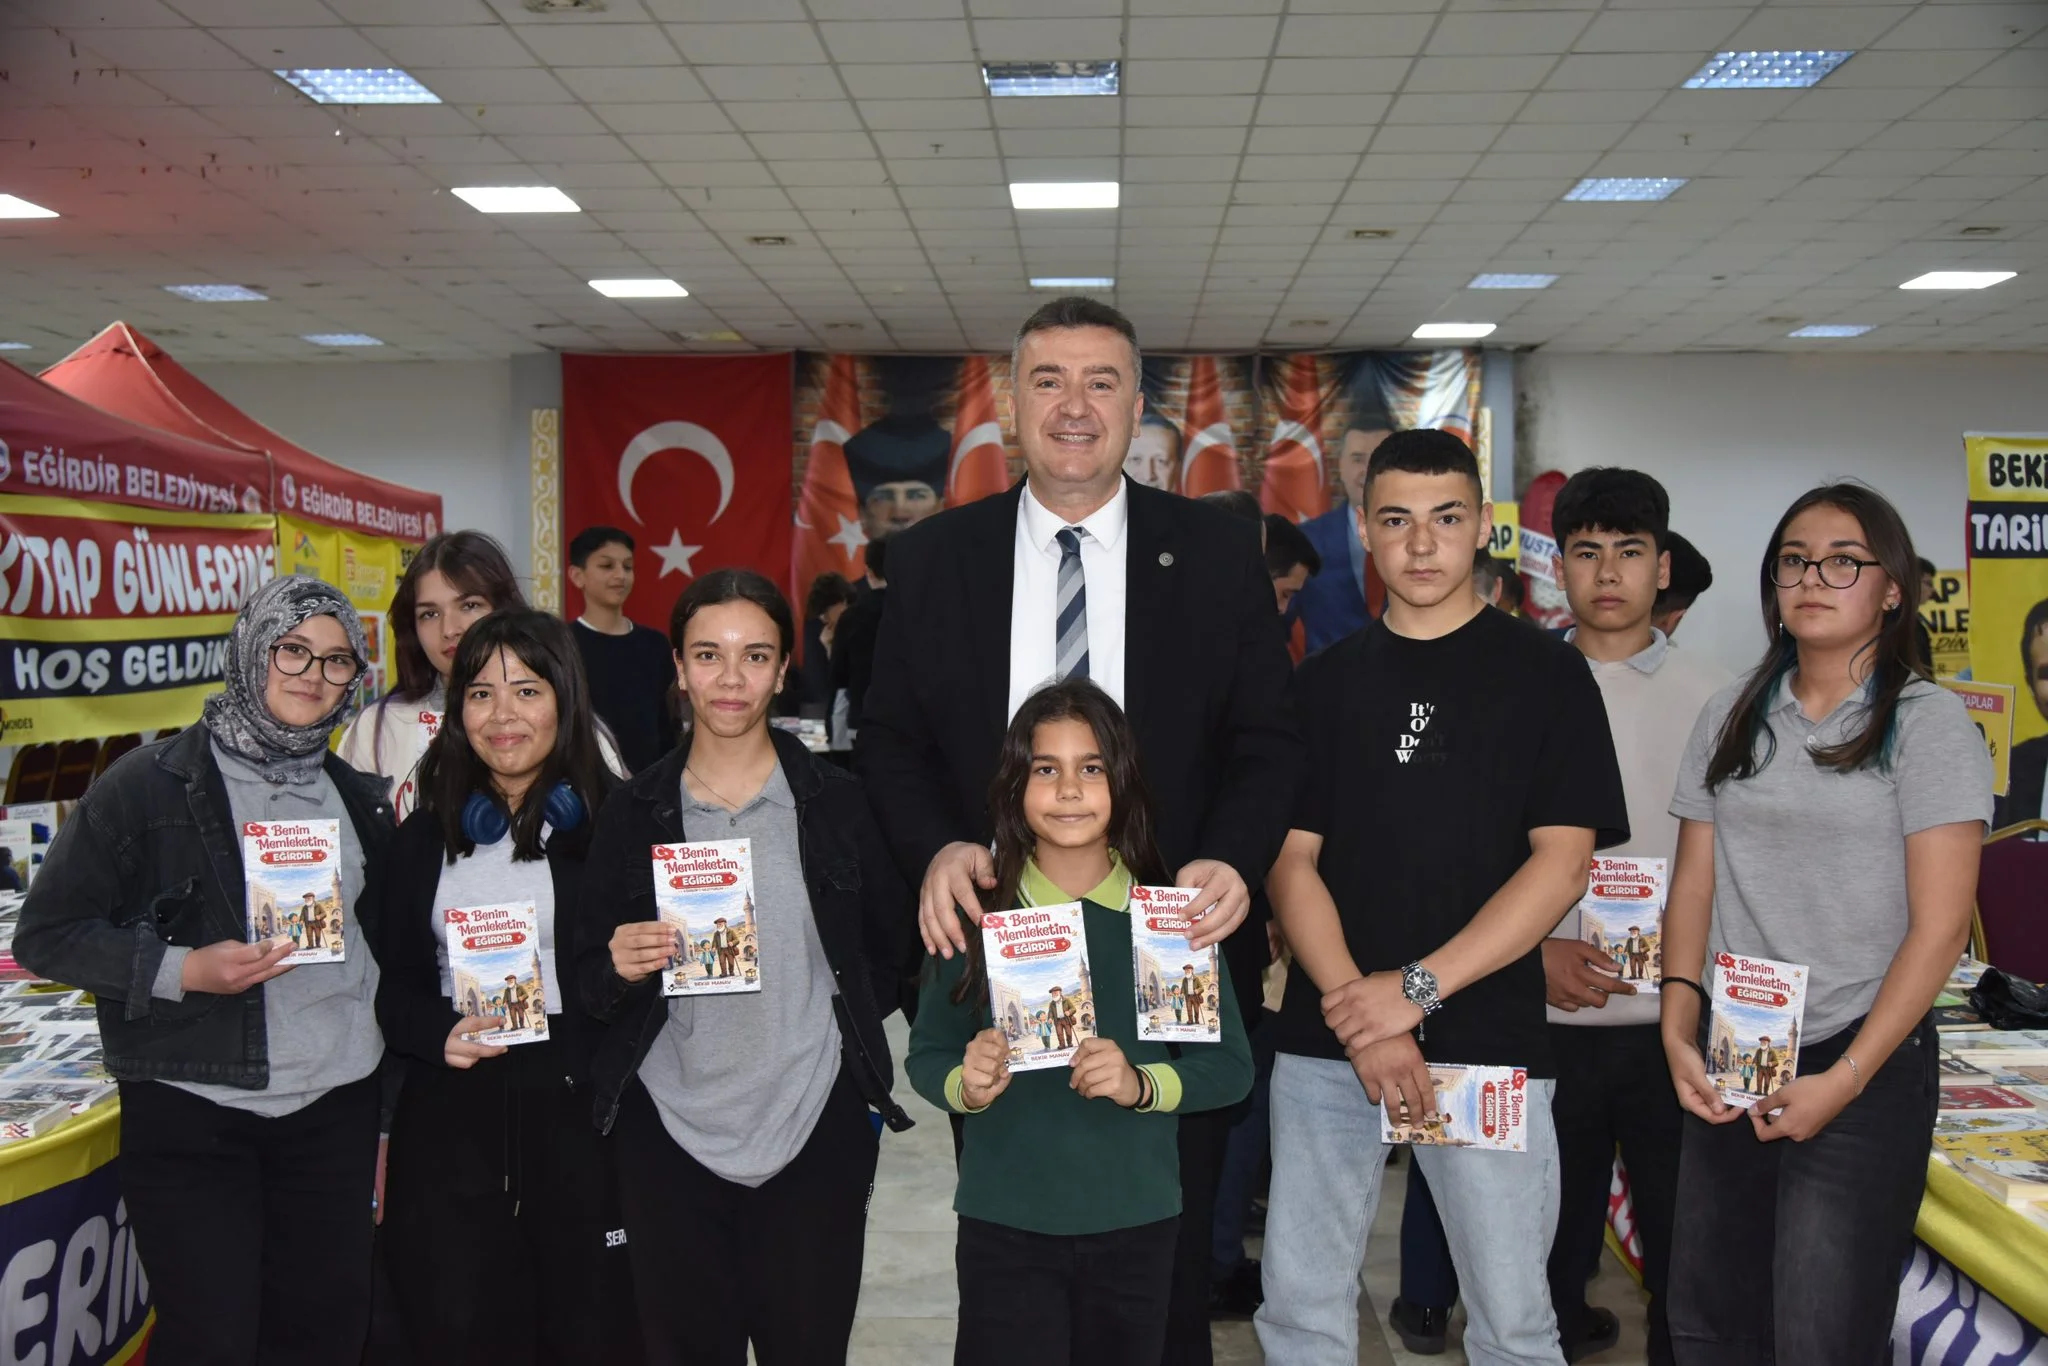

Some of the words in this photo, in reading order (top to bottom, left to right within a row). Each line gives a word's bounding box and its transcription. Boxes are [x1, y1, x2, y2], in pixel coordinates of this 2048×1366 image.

[23, 446, 119, 495] EĞİRDİR
[14, 647, 111, 693] HOŞ
[271, 825, 310, 836] Benim
[256, 837, 328, 851] Memleketim
[679, 846, 719, 860] Benim
[664, 858, 738, 874] Memleketim
[1603, 860, 1638, 870] Benim
[1590, 871, 1655, 884] Memleketim
[1154, 889, 1190, 902] Benim
[471, 908, 509, 921] Benim
[1009, 912, 1051, 927] Benim
[457, 919, 527, 937] Memleketim
[994, 923, 1072, 944] Memleketim
[1738, 959, 1775, 976] Benim
[1723, 970, 1791, 993] Memleketim
[1498, 1078, 1510, 1141] Memleketim
[1511, 1093, 1524, 1127] Benim
